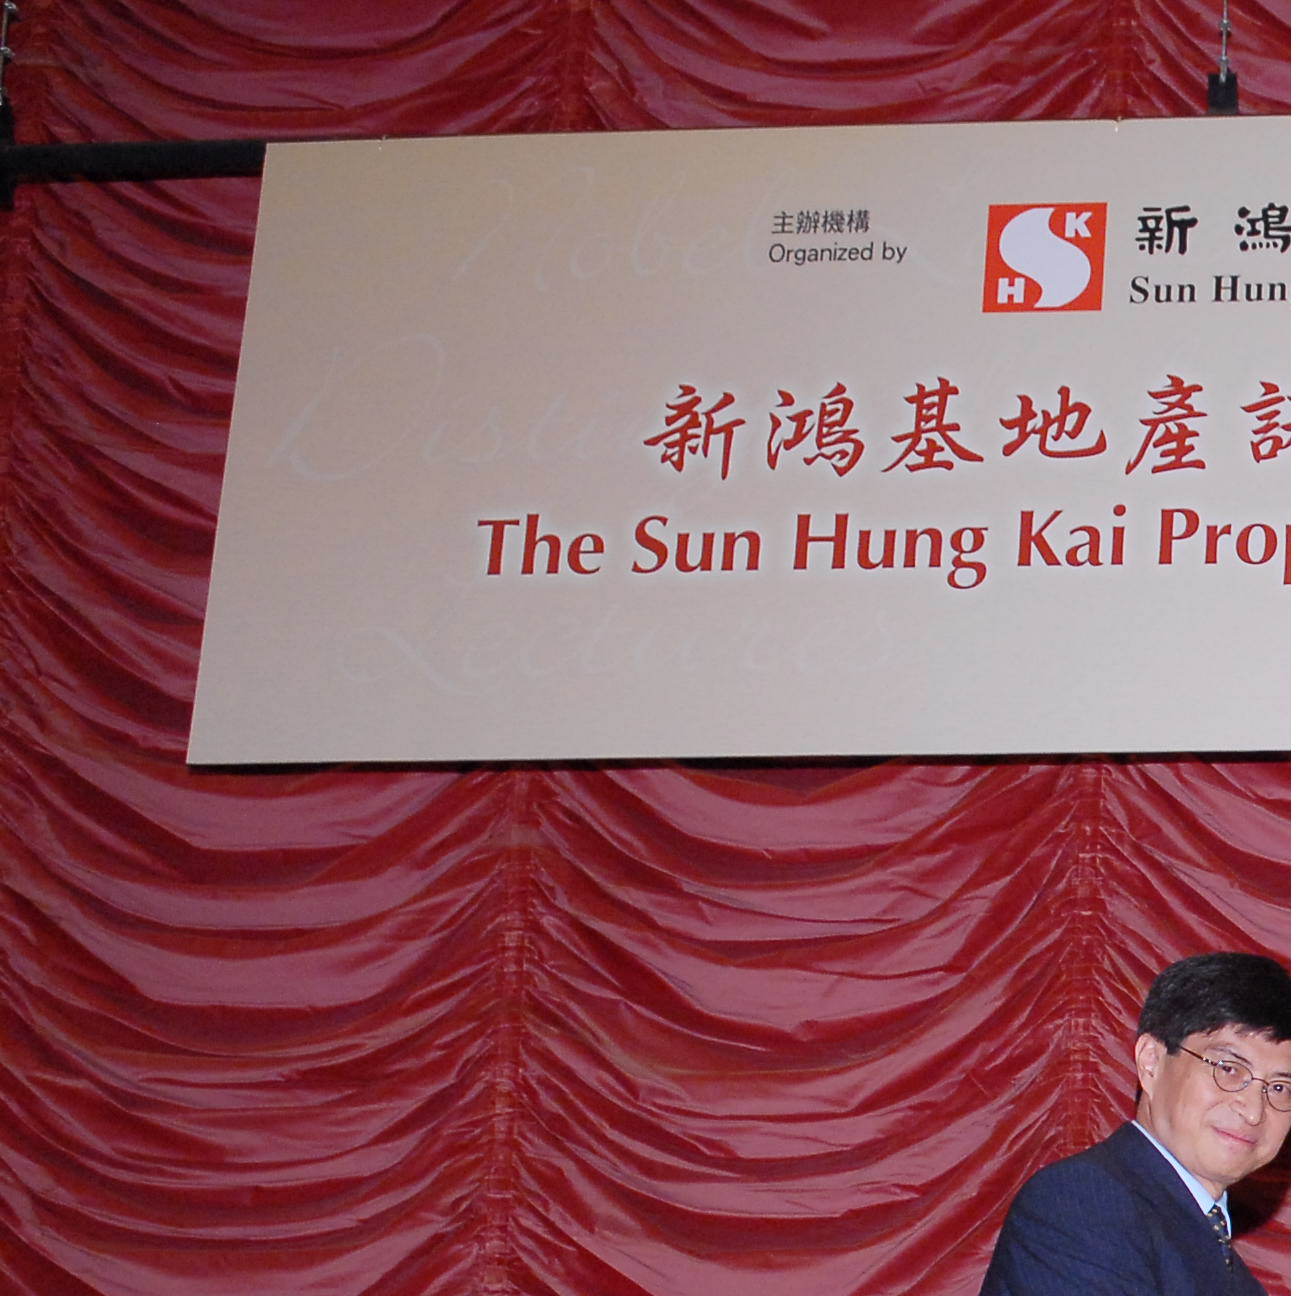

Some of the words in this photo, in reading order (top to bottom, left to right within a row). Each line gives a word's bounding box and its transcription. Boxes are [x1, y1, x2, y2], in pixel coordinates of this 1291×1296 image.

[772, 210, 869, 234] 主辦機構
[769, 242, 873, 266] Organized
[882, 241, 907, 263] by
[1130, 276, 1196, 304] Sun
[477, 514, 604, 575] The
[632, 513, 760, 574] Sun
[793, 513, 988, 589] Hung
[1017, 504, 1126, 567] Kai
